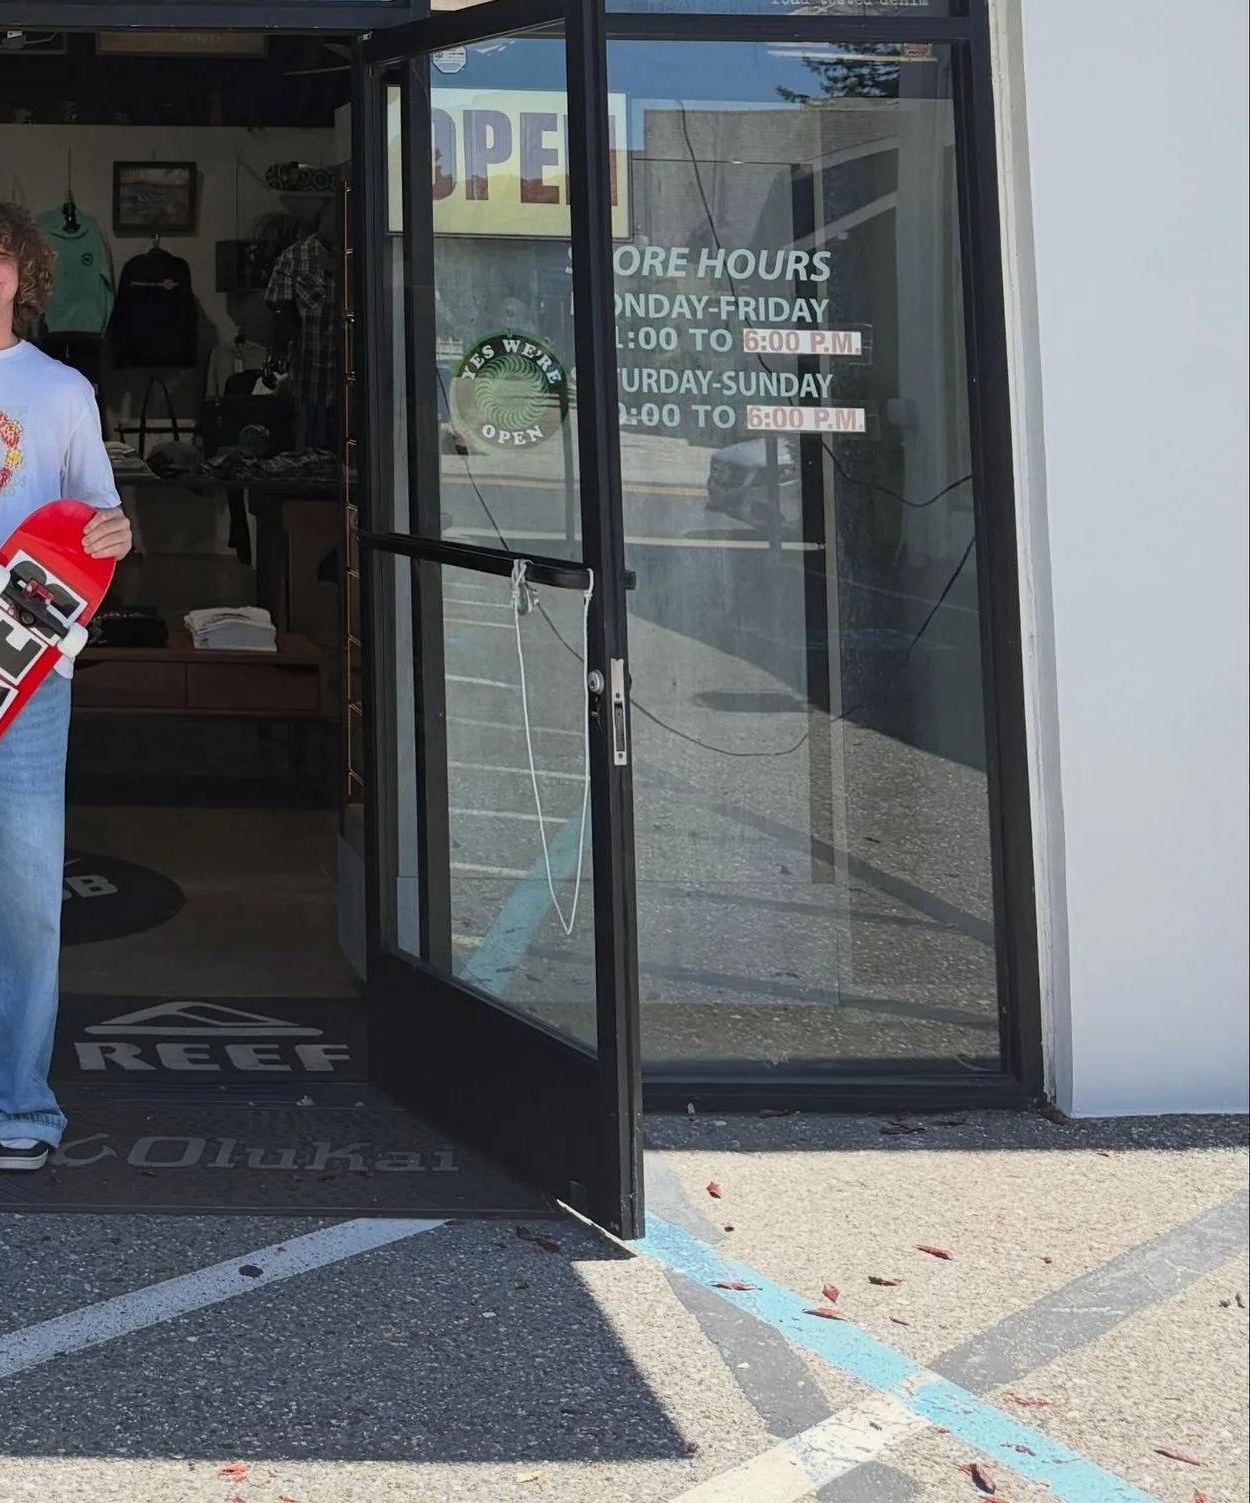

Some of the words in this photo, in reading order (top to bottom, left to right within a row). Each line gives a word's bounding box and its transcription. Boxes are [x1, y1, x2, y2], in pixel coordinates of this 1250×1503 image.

[431, 107, 618, 206] OPE
[566, 245, 690, 277] ORE
[697, 247, 831, 282] HOURS
[570, 292, 829, 323] NDAY-FRIDAY
[689, 328, 733, 352] TO
[744, 331, 800, 353] 6:00
[810, 332, 861, 354] P.M.
[461, 344, 495, 380] YES
[502, 339, 562, 384] WE'RE
[571, 367, 833, 398] URDAY-SUNDAY
[692, 405, 736, 428] TO
[750, 407, 804, 429] 6:00
[814, 408, 865, 430] P.M.
[481, 424, 544, 446] OPEN
[74, 1041, 351, 1072] REEF
[127, 1136, 460, 1173] OluKai
